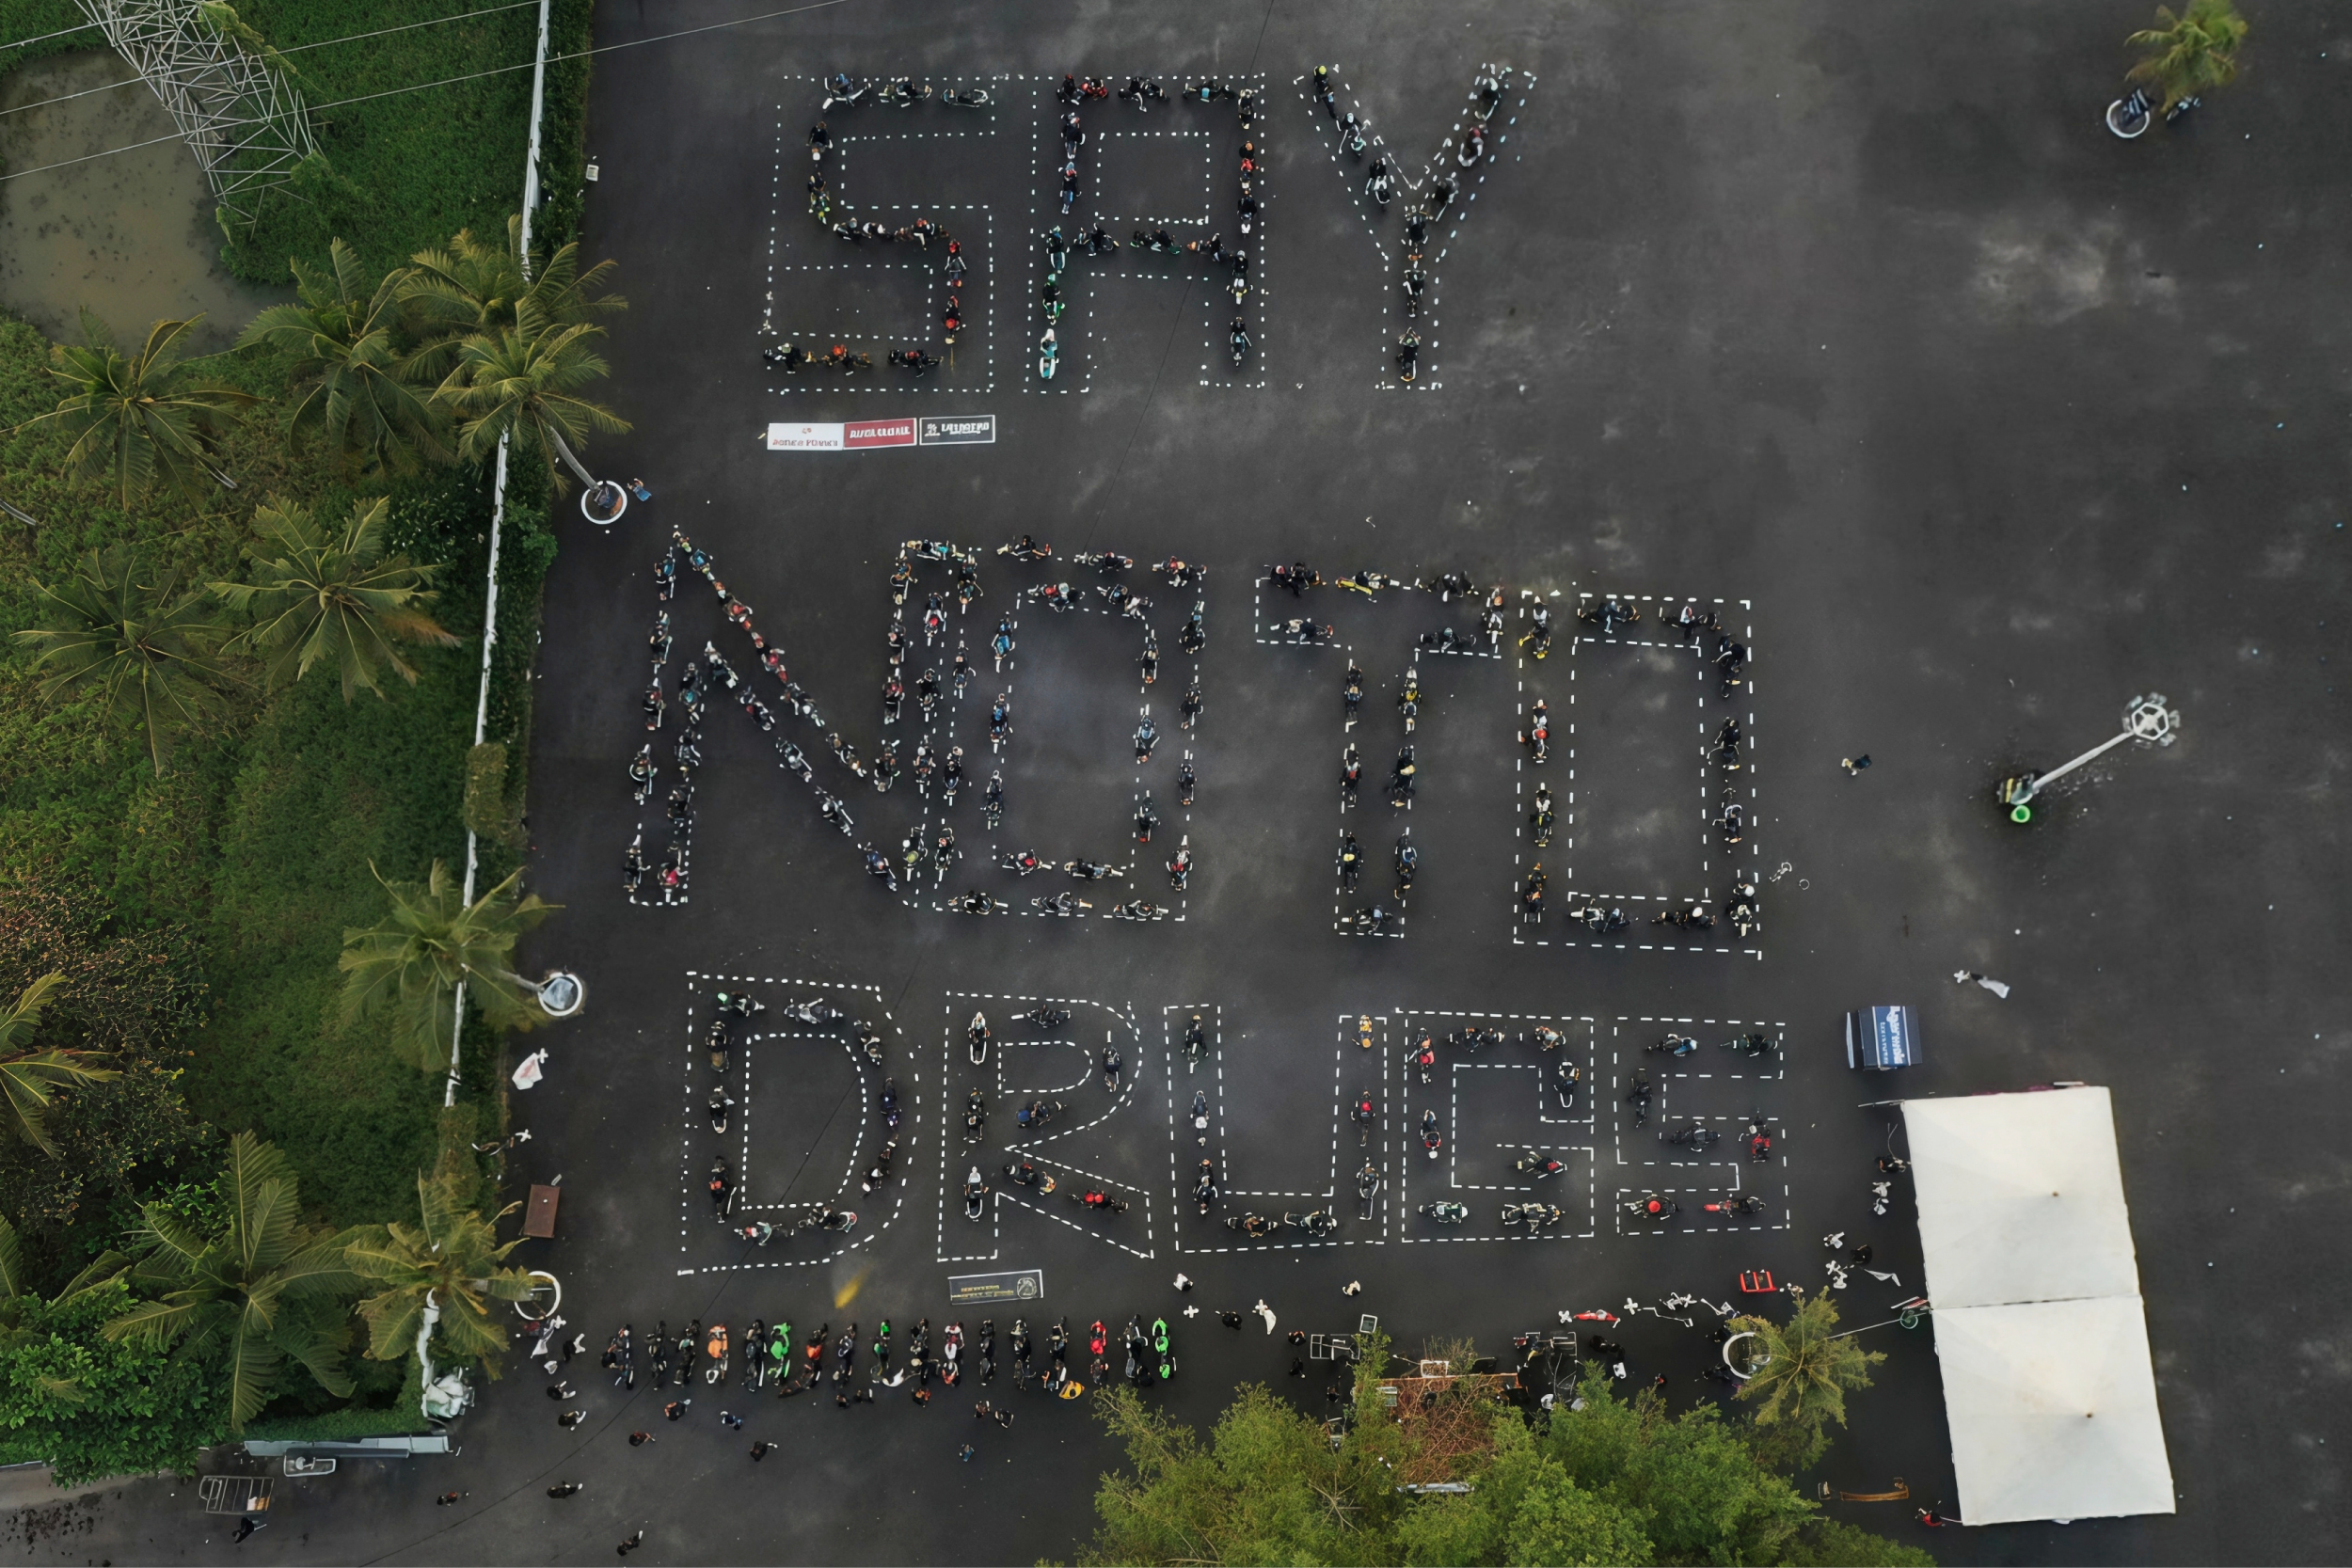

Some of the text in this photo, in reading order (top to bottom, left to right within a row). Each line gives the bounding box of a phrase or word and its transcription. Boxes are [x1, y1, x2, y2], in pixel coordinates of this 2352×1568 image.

[759, 61, 1537, 393] SAY
[628, 524, 1763, 961] NO TO
